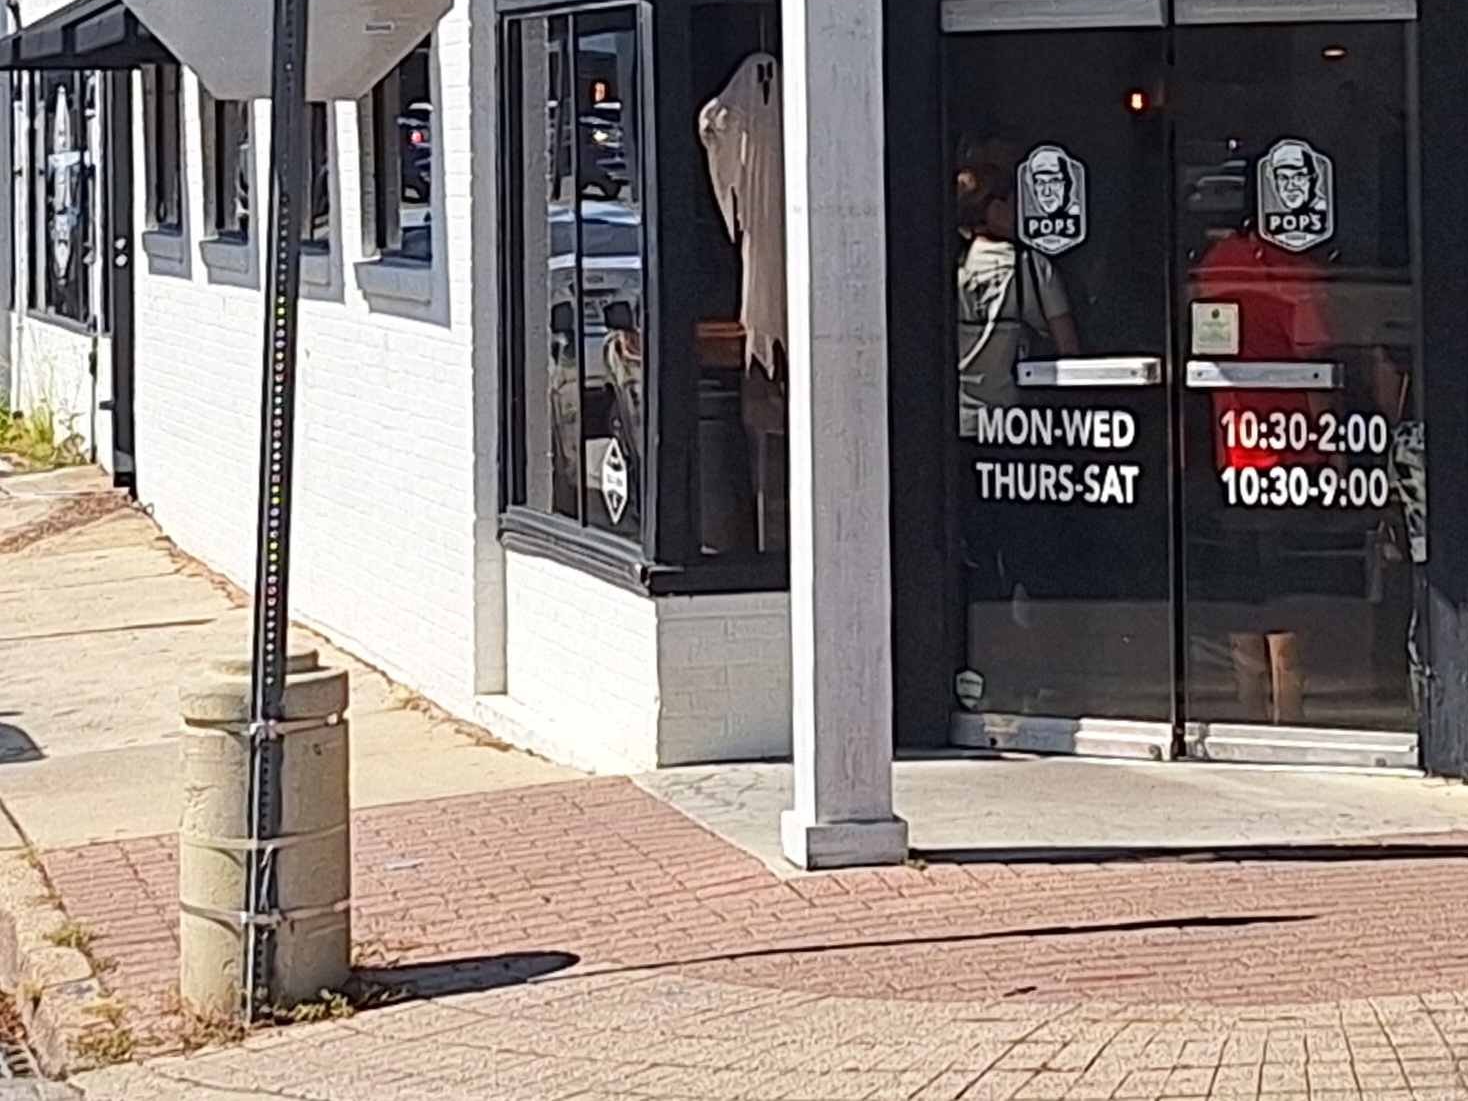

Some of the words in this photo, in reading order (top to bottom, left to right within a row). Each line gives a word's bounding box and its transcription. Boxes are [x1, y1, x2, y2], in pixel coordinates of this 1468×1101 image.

[975, 407, 1136, 448] MON-WED
[1220, 410, 1389, 453] 10:30-2:00
[975, 461, 1140, 504] THURS-SAT
[1220, 465, 1390, 507] 10:30-9:00
